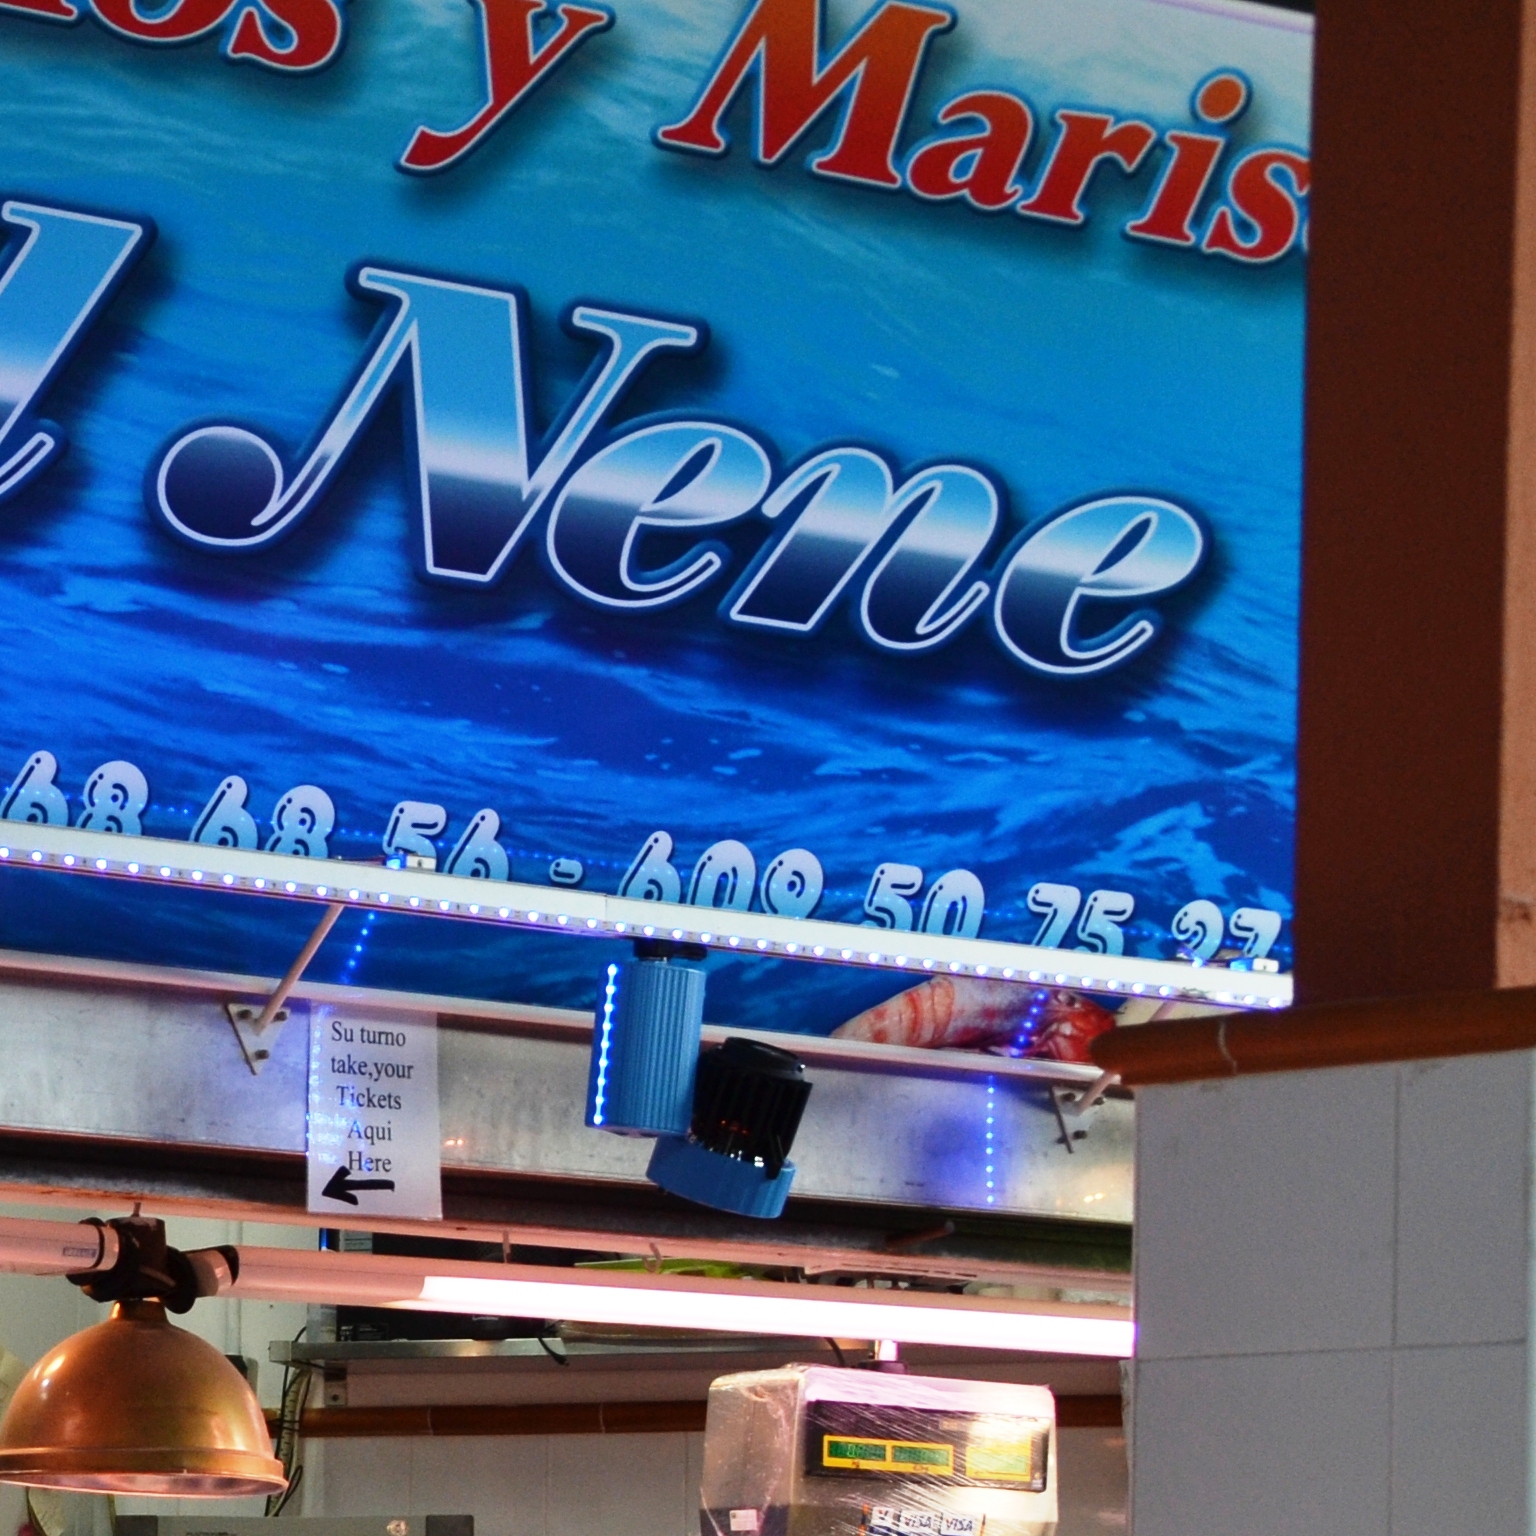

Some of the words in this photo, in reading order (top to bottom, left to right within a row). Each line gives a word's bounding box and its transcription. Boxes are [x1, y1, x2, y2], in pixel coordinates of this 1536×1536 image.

[656, 0, 1310, 266] Maris
[157, 266, 1204, 674] Nene
[189, 775, 336, 860] 68
[382, 800, 509, 881] 56
[863, 862, 985, 939] 50
[1027, 883, 1134, 957] 75
[331, 1021, 355, 1044] Su
[360, 1025, 406, 1048] turno
[336, 1086, 402, 1110] Tickets
[347, 1121, 392, 1149] Aqui
[348, 1150, 392, 1173] Here
